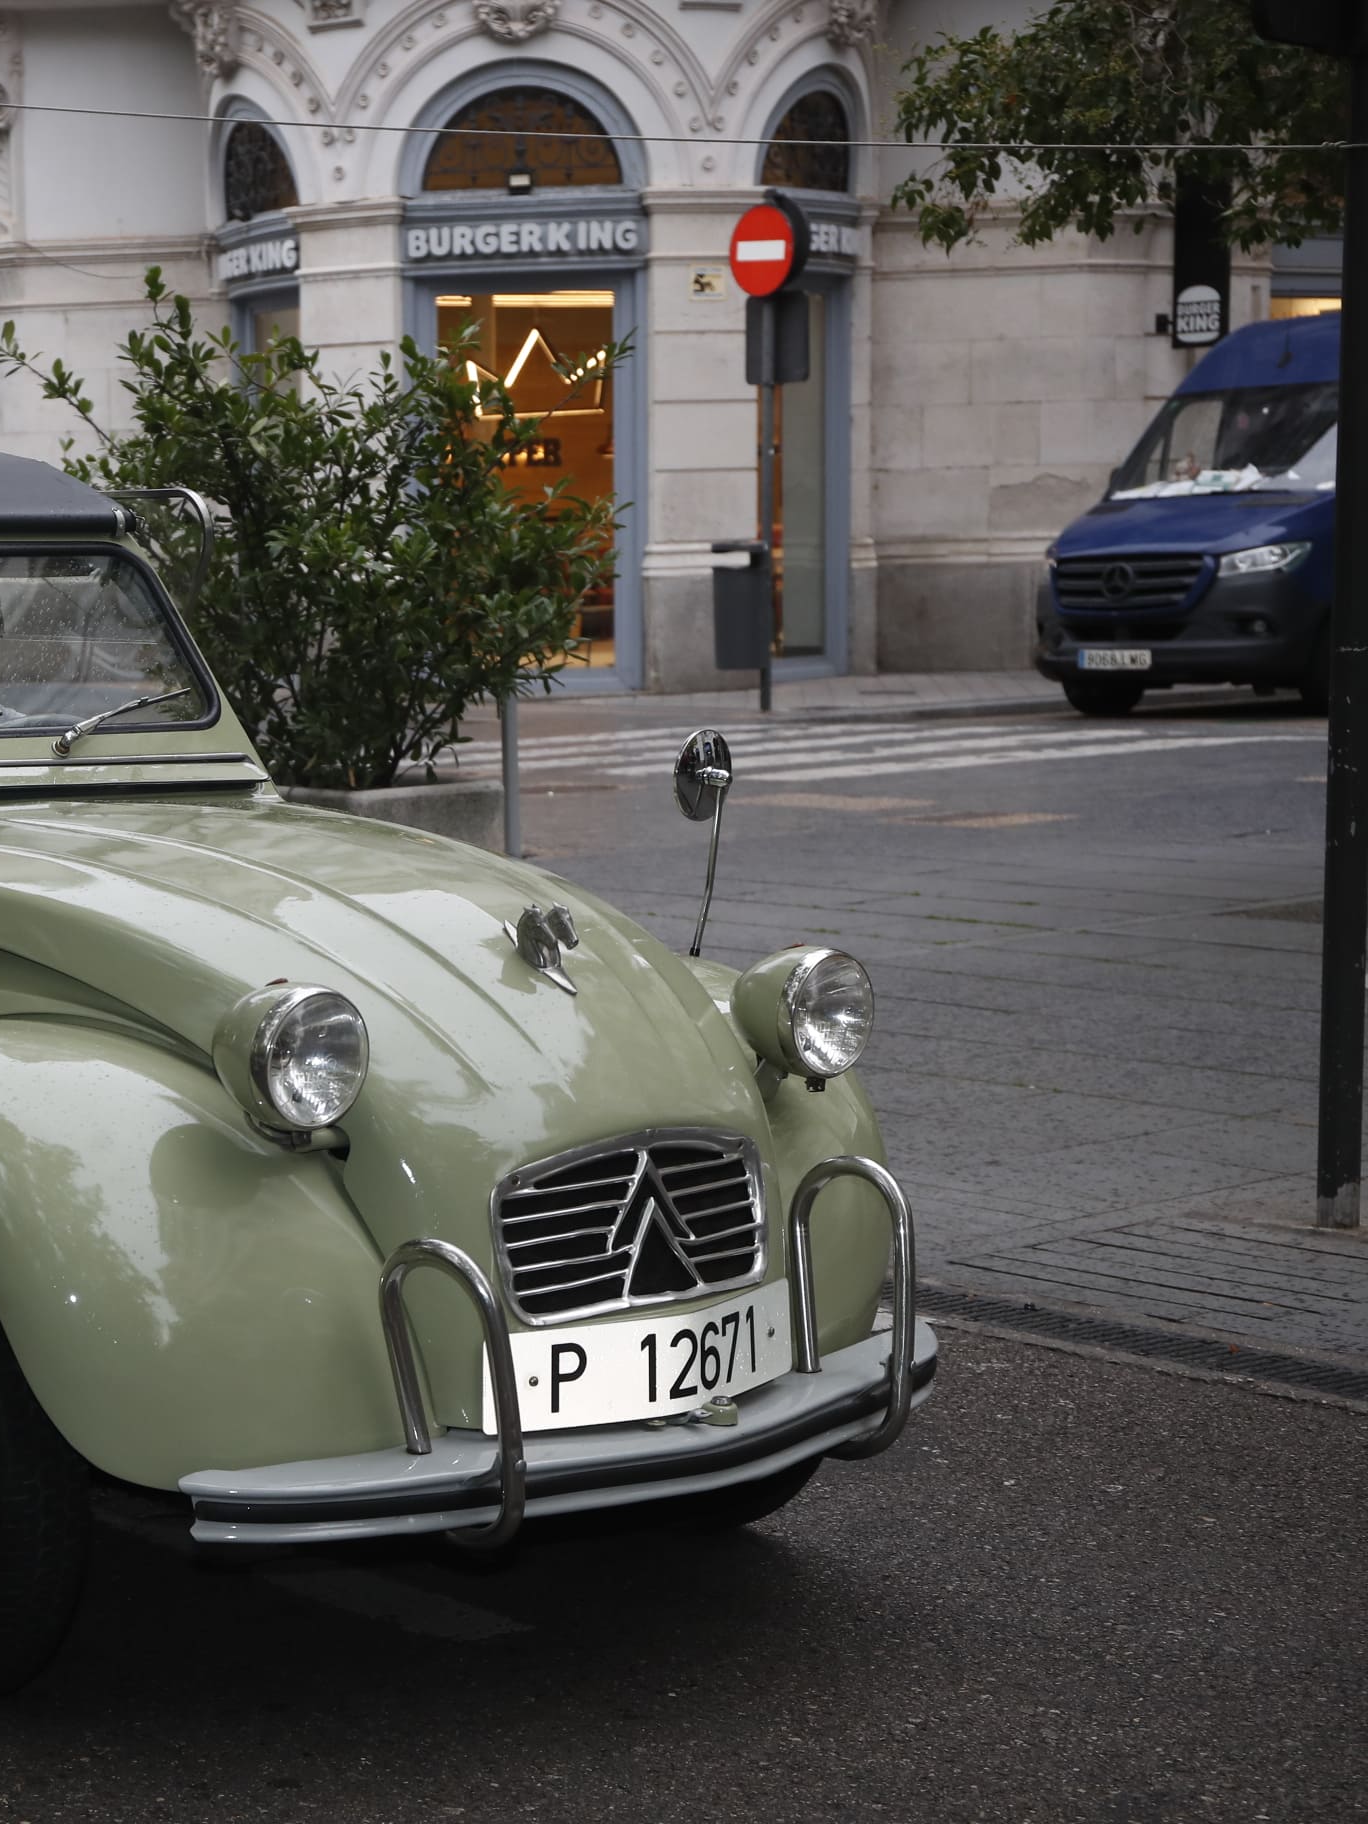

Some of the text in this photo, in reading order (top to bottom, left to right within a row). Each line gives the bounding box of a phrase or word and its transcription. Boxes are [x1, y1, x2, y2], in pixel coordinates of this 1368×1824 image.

[249, 239, 297, 272] KING
[406, 220, 638, 258] BURGER KING
[1177, 314, 1220, 331] KING
[551, 1304, 757, 1413] P 12671
